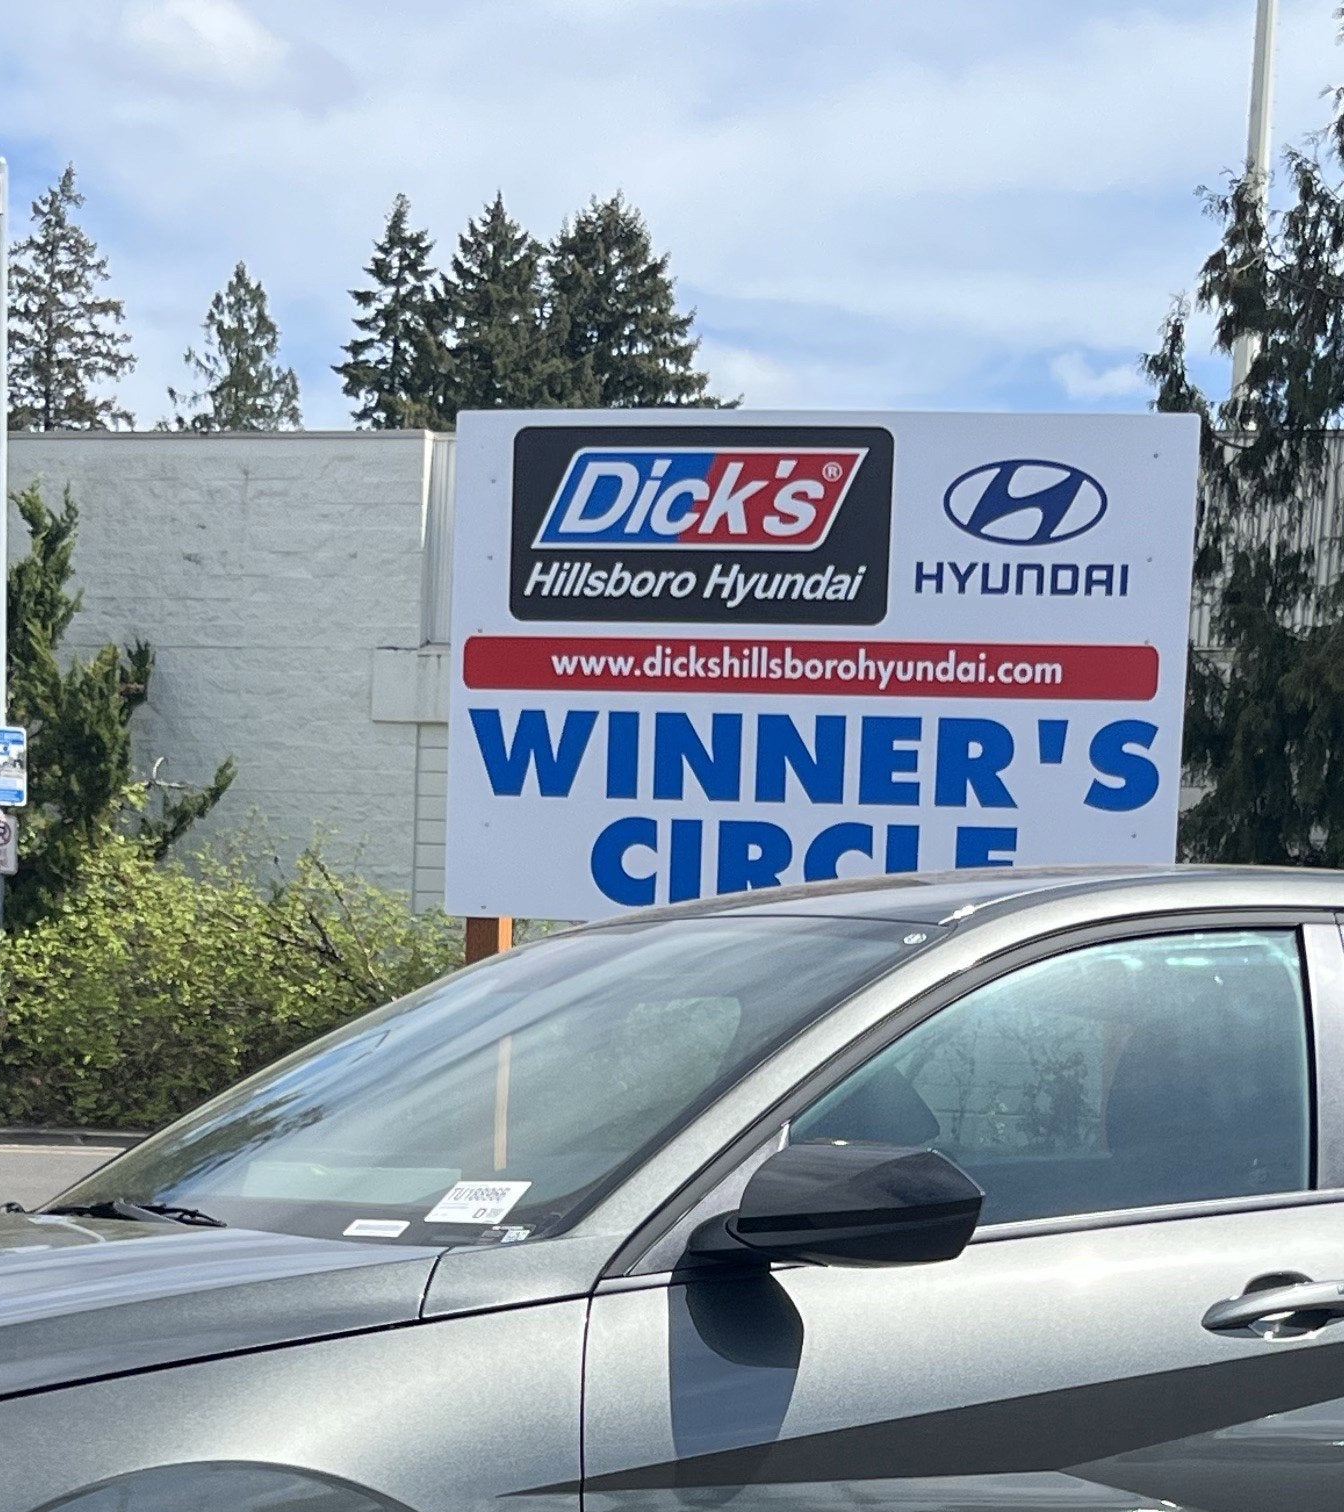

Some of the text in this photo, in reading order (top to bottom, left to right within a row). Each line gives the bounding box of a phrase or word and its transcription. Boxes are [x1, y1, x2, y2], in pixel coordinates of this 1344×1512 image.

[558, 459, 824, 536] Dick's
[524, 562, 867, 608] Hillsboro Hyundai
[915, 562, 1129, 597] HYUNDAI
[552, 646, 1063, 689] www.dickshillsborohyundai.com
[468, 709, 1159, 811] WINNER'S
